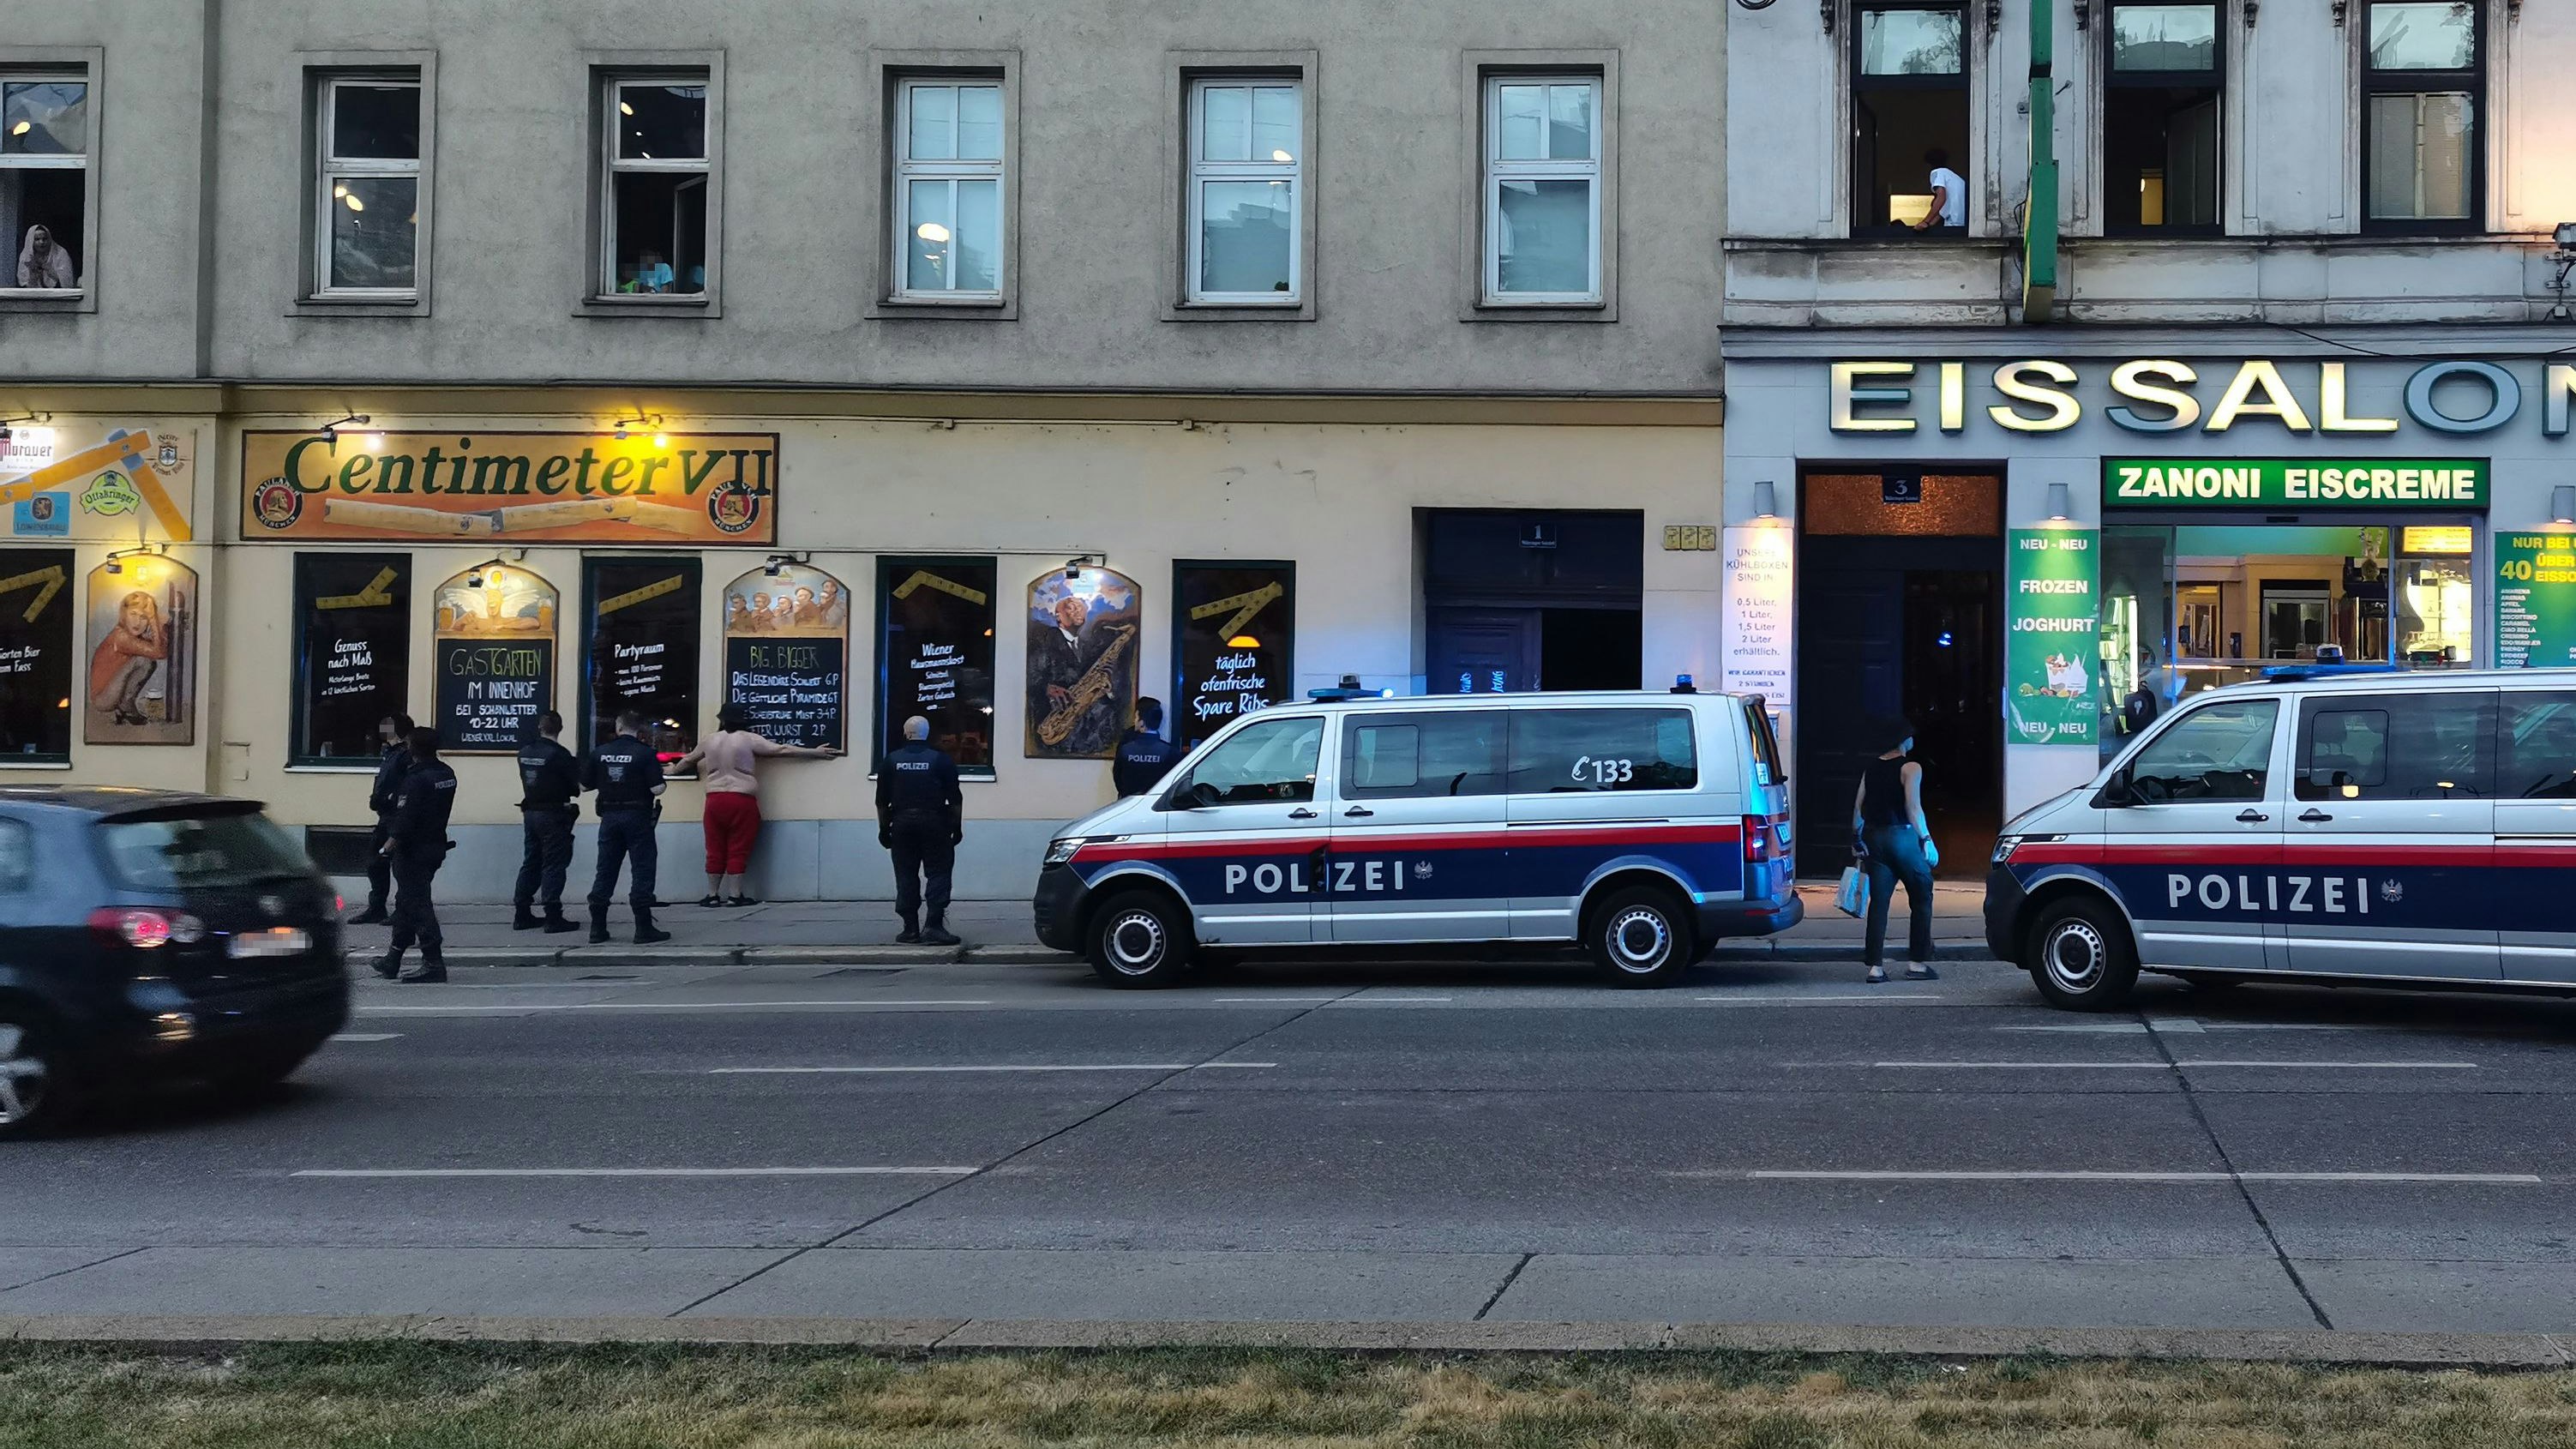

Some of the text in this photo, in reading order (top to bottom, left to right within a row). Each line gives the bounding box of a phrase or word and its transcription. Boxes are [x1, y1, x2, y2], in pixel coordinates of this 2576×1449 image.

[285, 436, 772, 496] Centimeter VII
[1894, 479, 1908, 495] 3
[2117, 467, 2476, 500] ZANONI EISCREME
[1534, 524, 1542, 539] 1
[2020, 538, 2048, 550] NEU
[2059, 538, 2088, 550] NEU
[2513, 537, 2543, 549] NUR
[2547, 537, 2570, 550] BEI
[1726, 559, 1788, 569] KÜHLBOXEN
[2537, 552, 2575, 568] ÜBER
[1737, 573, 1762, 581] SIND
[2500, 560, 2532, 580] 40
[2020, 580, 2088, 594] FROZEN
[1738, 622, 1752, 632] 1,5
[2013, 618, 2095, 633] JOGHURT
[335, 639, 368, 652] Genuss
[1742, 634, 1748, 643] 2
[615, 644, 664, 660] Partyraum
[922, 643, 954, 657] Wiener
[328, 652, 372, 669] nach Maß
[1216, 652, 1256, 674] täglich
[733, 671, 748, 686] DAS
[1201, 672, 1265, 692] ofenfrische
[468, 682, 538, 699] IM INNENHOF
[456, 705, 471, 715] BEI
[1193, 693, 1270, 722] Spare Ribs
[470, 717, 519, 729] 10-22 UHR
[2058, 722, 2087, 734] NEU
[600, 755, 633, 763] POLIZEI
[1127, 754, 1161, 763] POLIZEI
[1592, 759, 1633, 783] 133
[1225, 860, 1404, 894] POLZEI
[2168, 873, 2369, 914] POLIZEI
